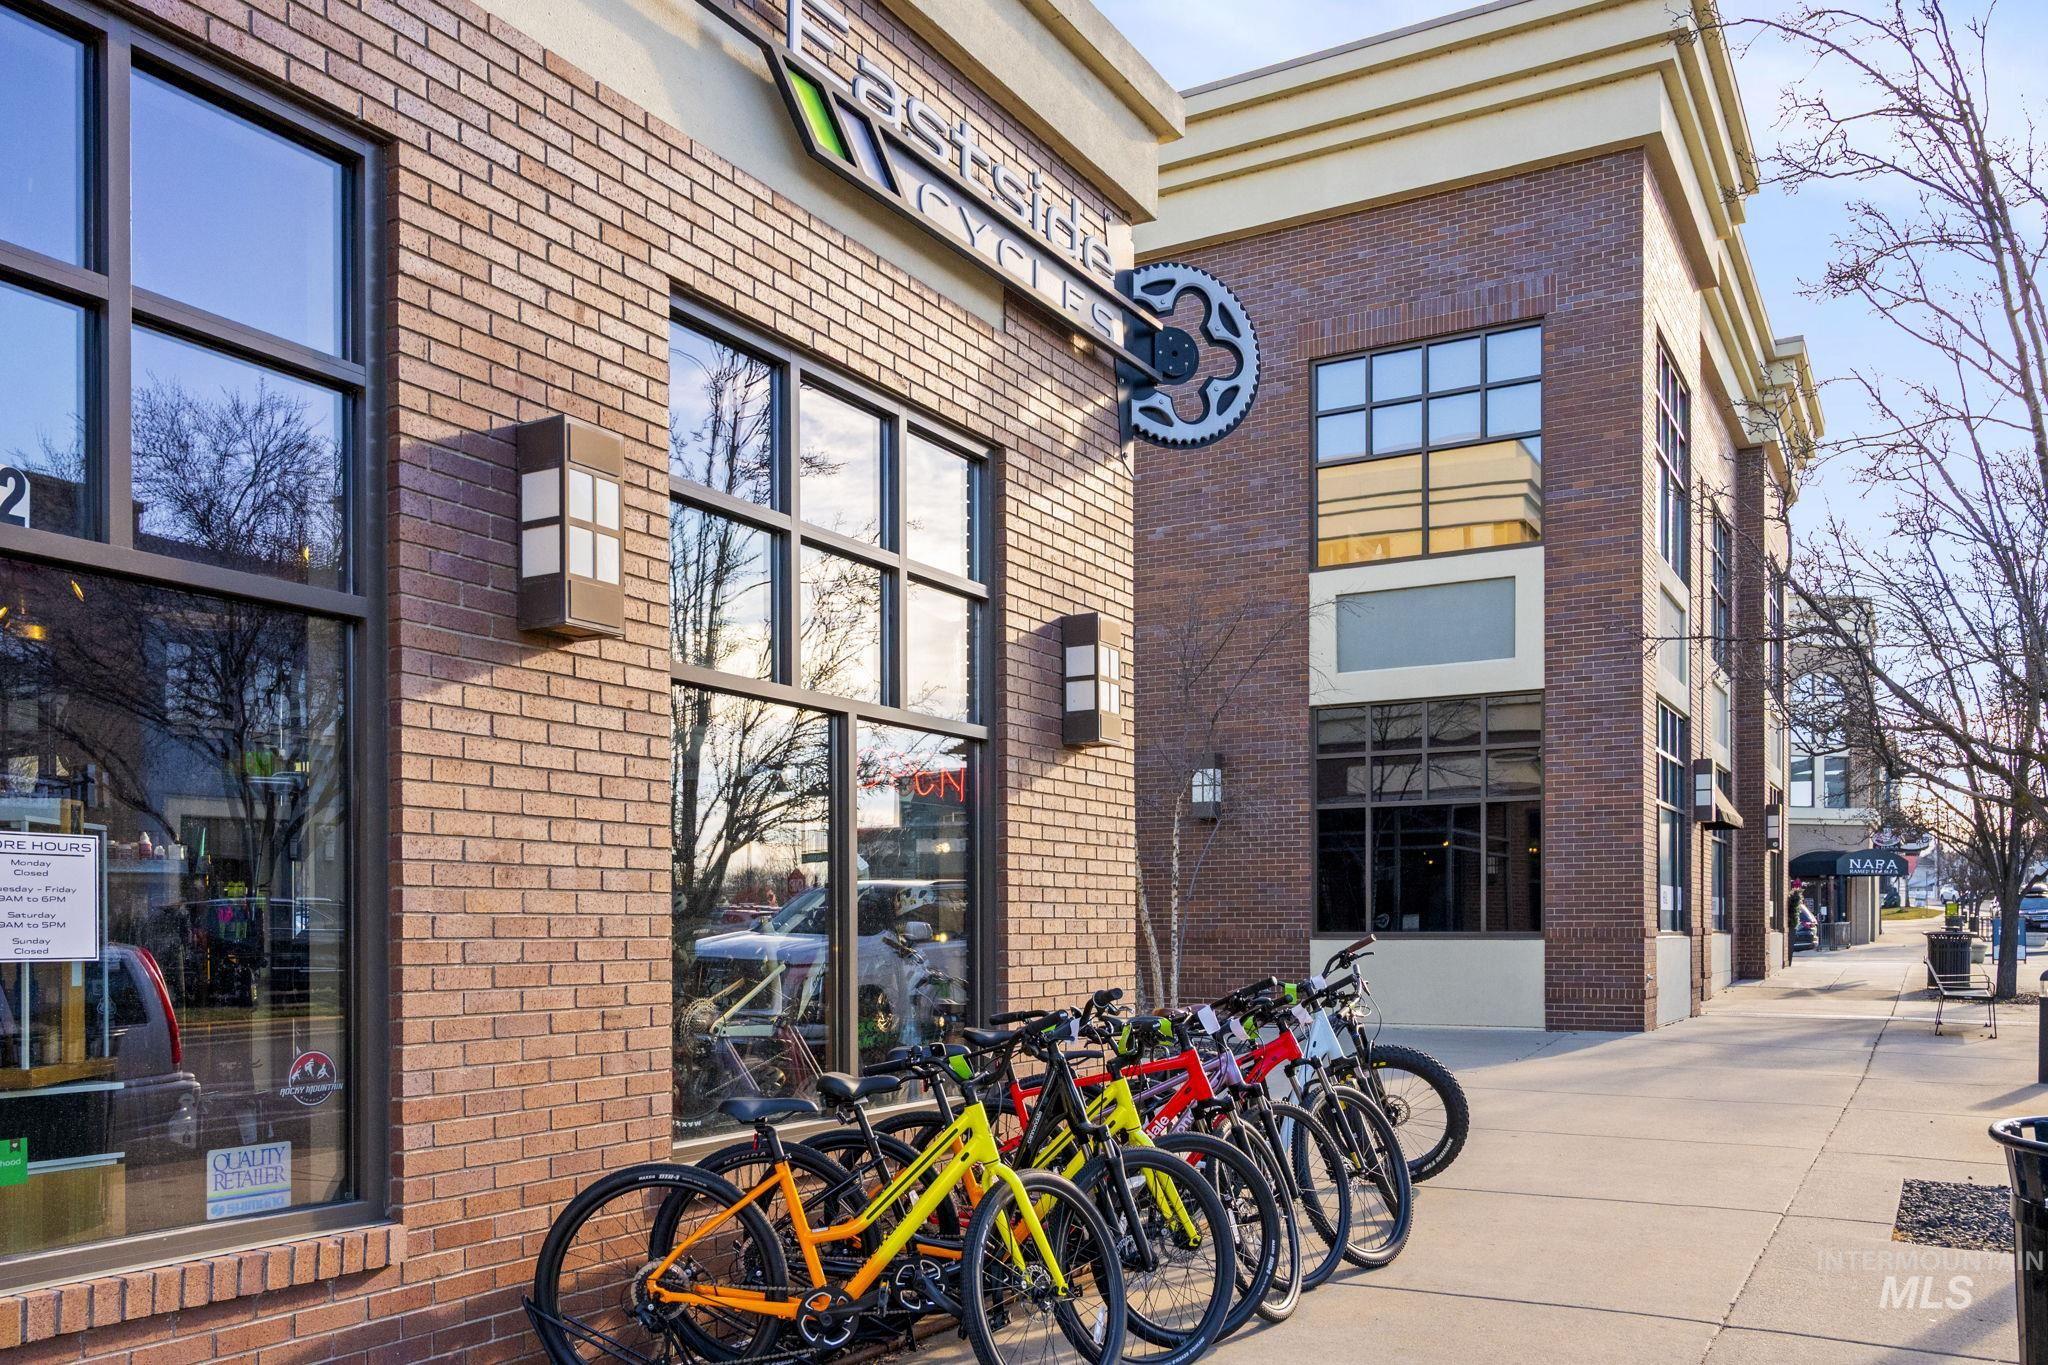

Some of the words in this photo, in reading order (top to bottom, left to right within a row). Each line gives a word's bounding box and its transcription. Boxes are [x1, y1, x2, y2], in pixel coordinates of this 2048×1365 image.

[788, 0, 1116, 290] Eastside
[916, 182, 1117, 342] CYCLES
[0, 840, 26, 850] RE
[32, 841, 92, 853] HOURS
[11, 859, 51, 868] Monday
[1849, 859, 1898, 870] NARA
[13, 869, 49, 877] Closed
[45, 886, 77, 894] Friday
[41, 895, 66, 903] 6PM
[7, 911, 56, 919] Saturday
[42, 921, 66, 929] 5PM
[12, 937, 51, 945] Sunday
[14, 947, 49, 955] Closed
[280, 1086, 305, 1097] ROCKY
[305, 1083, 344, 1095] MOUNTAIN
[213, 1146, 286, 1174] QUALITY
[212, 1165, 287, 1191] RETAILER
